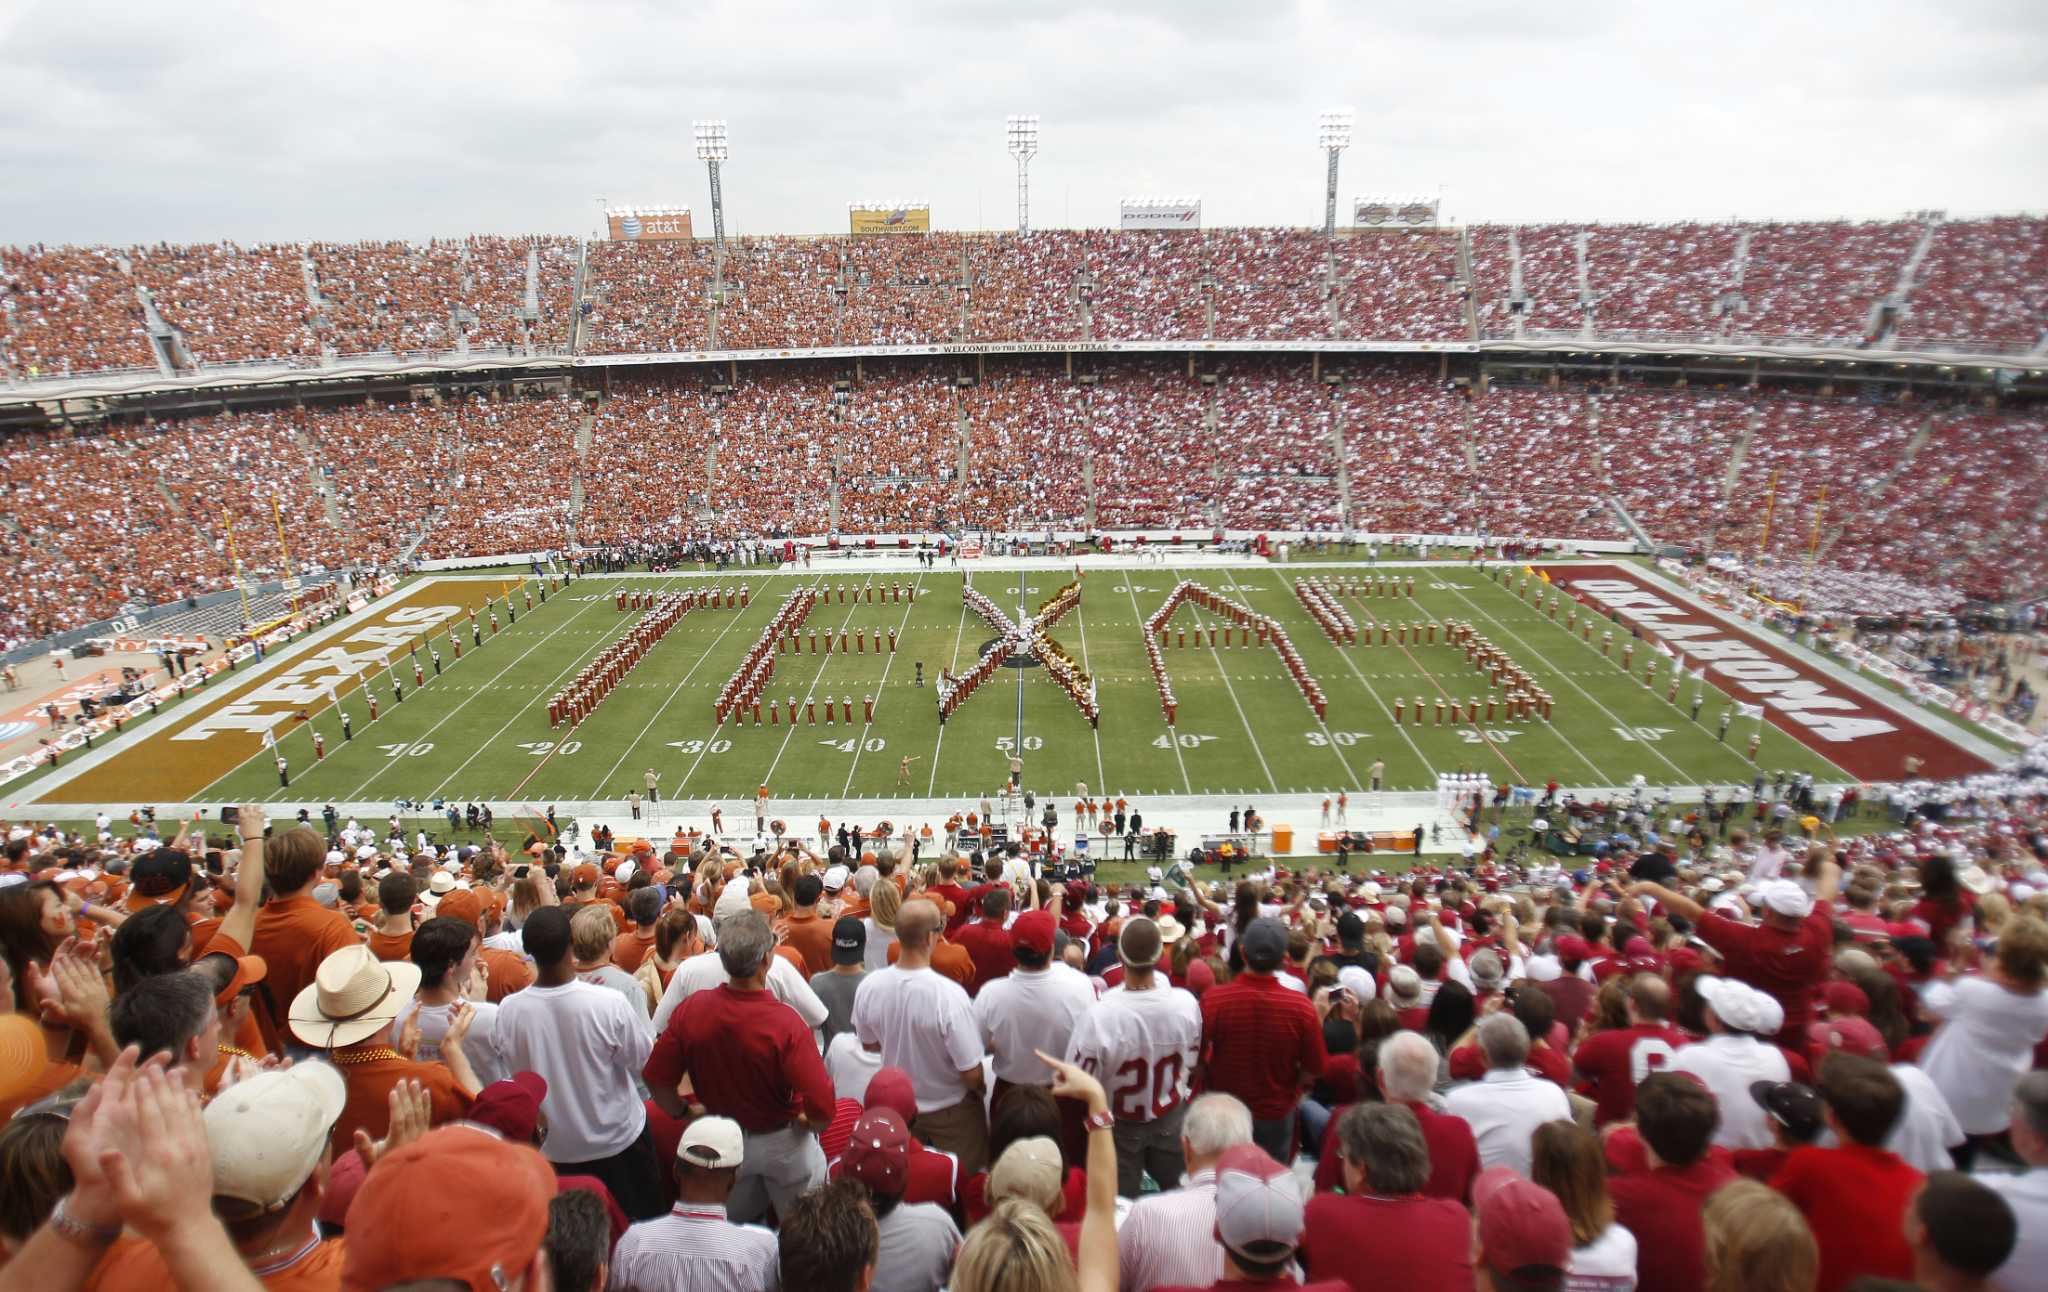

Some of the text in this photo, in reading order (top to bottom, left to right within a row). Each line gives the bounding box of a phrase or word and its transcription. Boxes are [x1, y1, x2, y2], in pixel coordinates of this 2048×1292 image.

[646, 219, 681, 234] at&t
[861, 224, 919, 232] SOUTHWEST.COM
[1569, 579, 1900, 741] OKLAHOMA
[169, 605, 462, 740] TEXAS
[1151, 734, 1201, 748] 40
[1305, 732, 1361, 746] 30
[1456, 730, 1515, 744] 20
[1611, 727, 1662, 741] 10
[384, 743, 435, 757] 10
[527, 741, 583, 755] 20
[680, 740, 732, 753] 30
[835, 738, 886, 753] 40
[994, 736, 1043, 751] 50
[1113, 1051, 1184, 1122] 20
